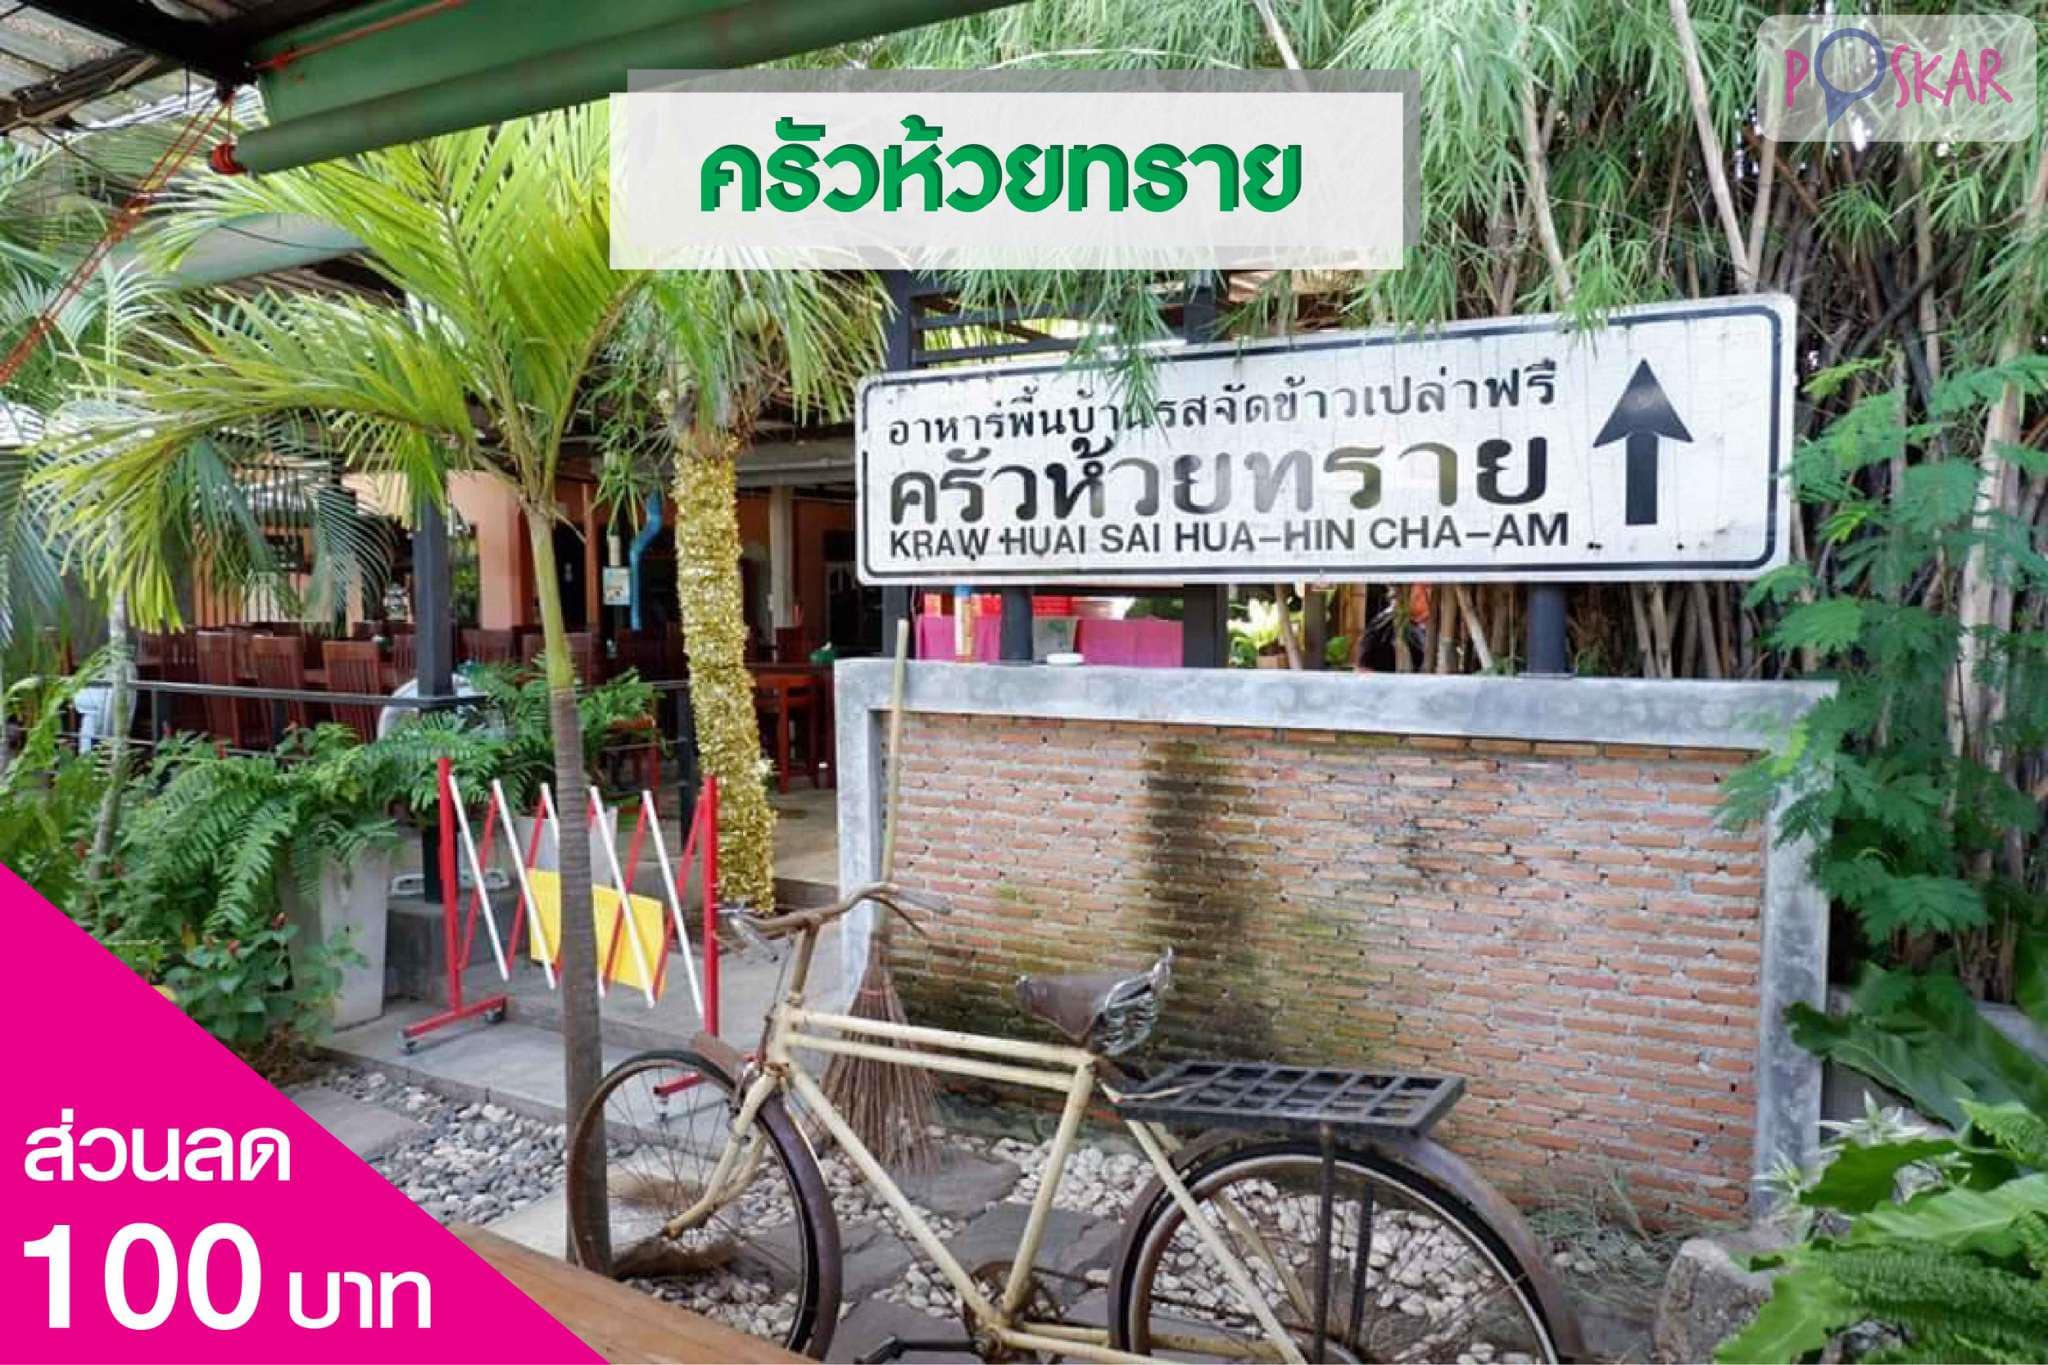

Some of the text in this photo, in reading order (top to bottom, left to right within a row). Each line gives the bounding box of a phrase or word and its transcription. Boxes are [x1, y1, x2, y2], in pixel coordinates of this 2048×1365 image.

[889, 434, 1549, 525] ครัวห้วยทราย
[890, 512, 1568, 558] KRAW HUAI SAI HUA-HIN CHA-AM
